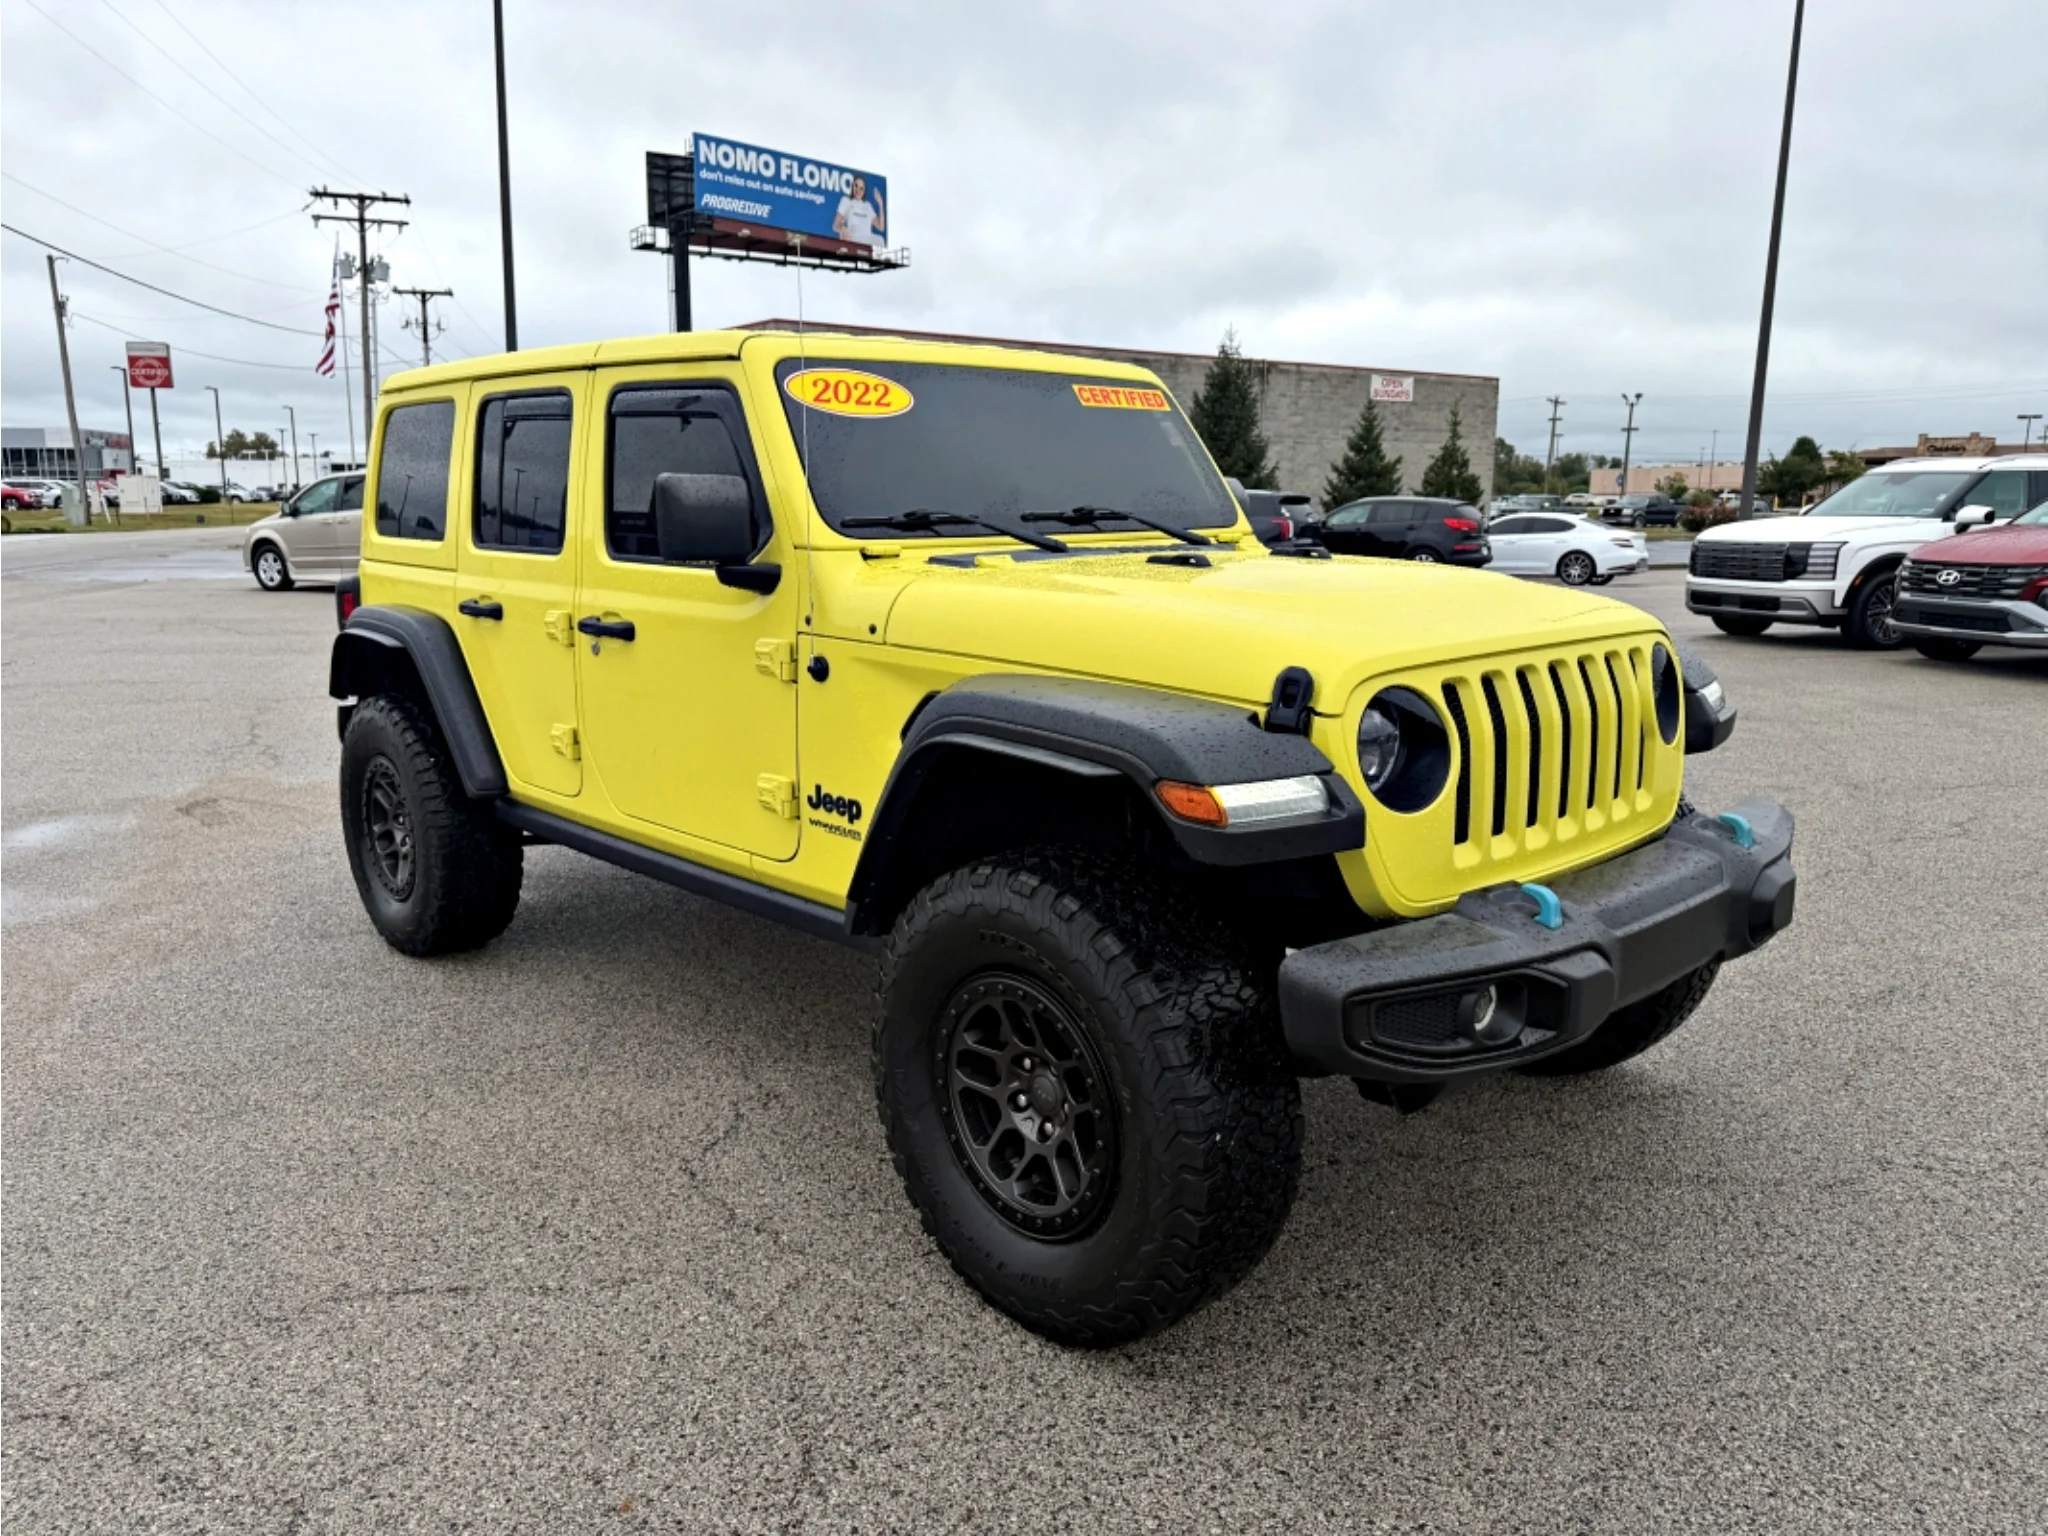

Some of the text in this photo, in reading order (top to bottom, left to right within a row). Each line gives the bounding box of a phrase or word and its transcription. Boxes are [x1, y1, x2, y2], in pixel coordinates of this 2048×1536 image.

[698, 139, 855, 196] NOMO FLOMO
[699, 168, 723, 182] don't
[724, 174, 745, 187] miss
[746, 180, 761, 190] out
[762, 182, 774, 193] on
[794, 190, 826, 205] savings
[701, 193, 773, 218] PROGRESSIVE
[812, 378, 892, 408] 2022
[1373, 388, 1410, 400] SUNDAYS
[1381, 377, 1404, 388] OPEN
[1078, 387, 1166, 408] CERTIFIED
[807, 783, 862, 825] Jeep
